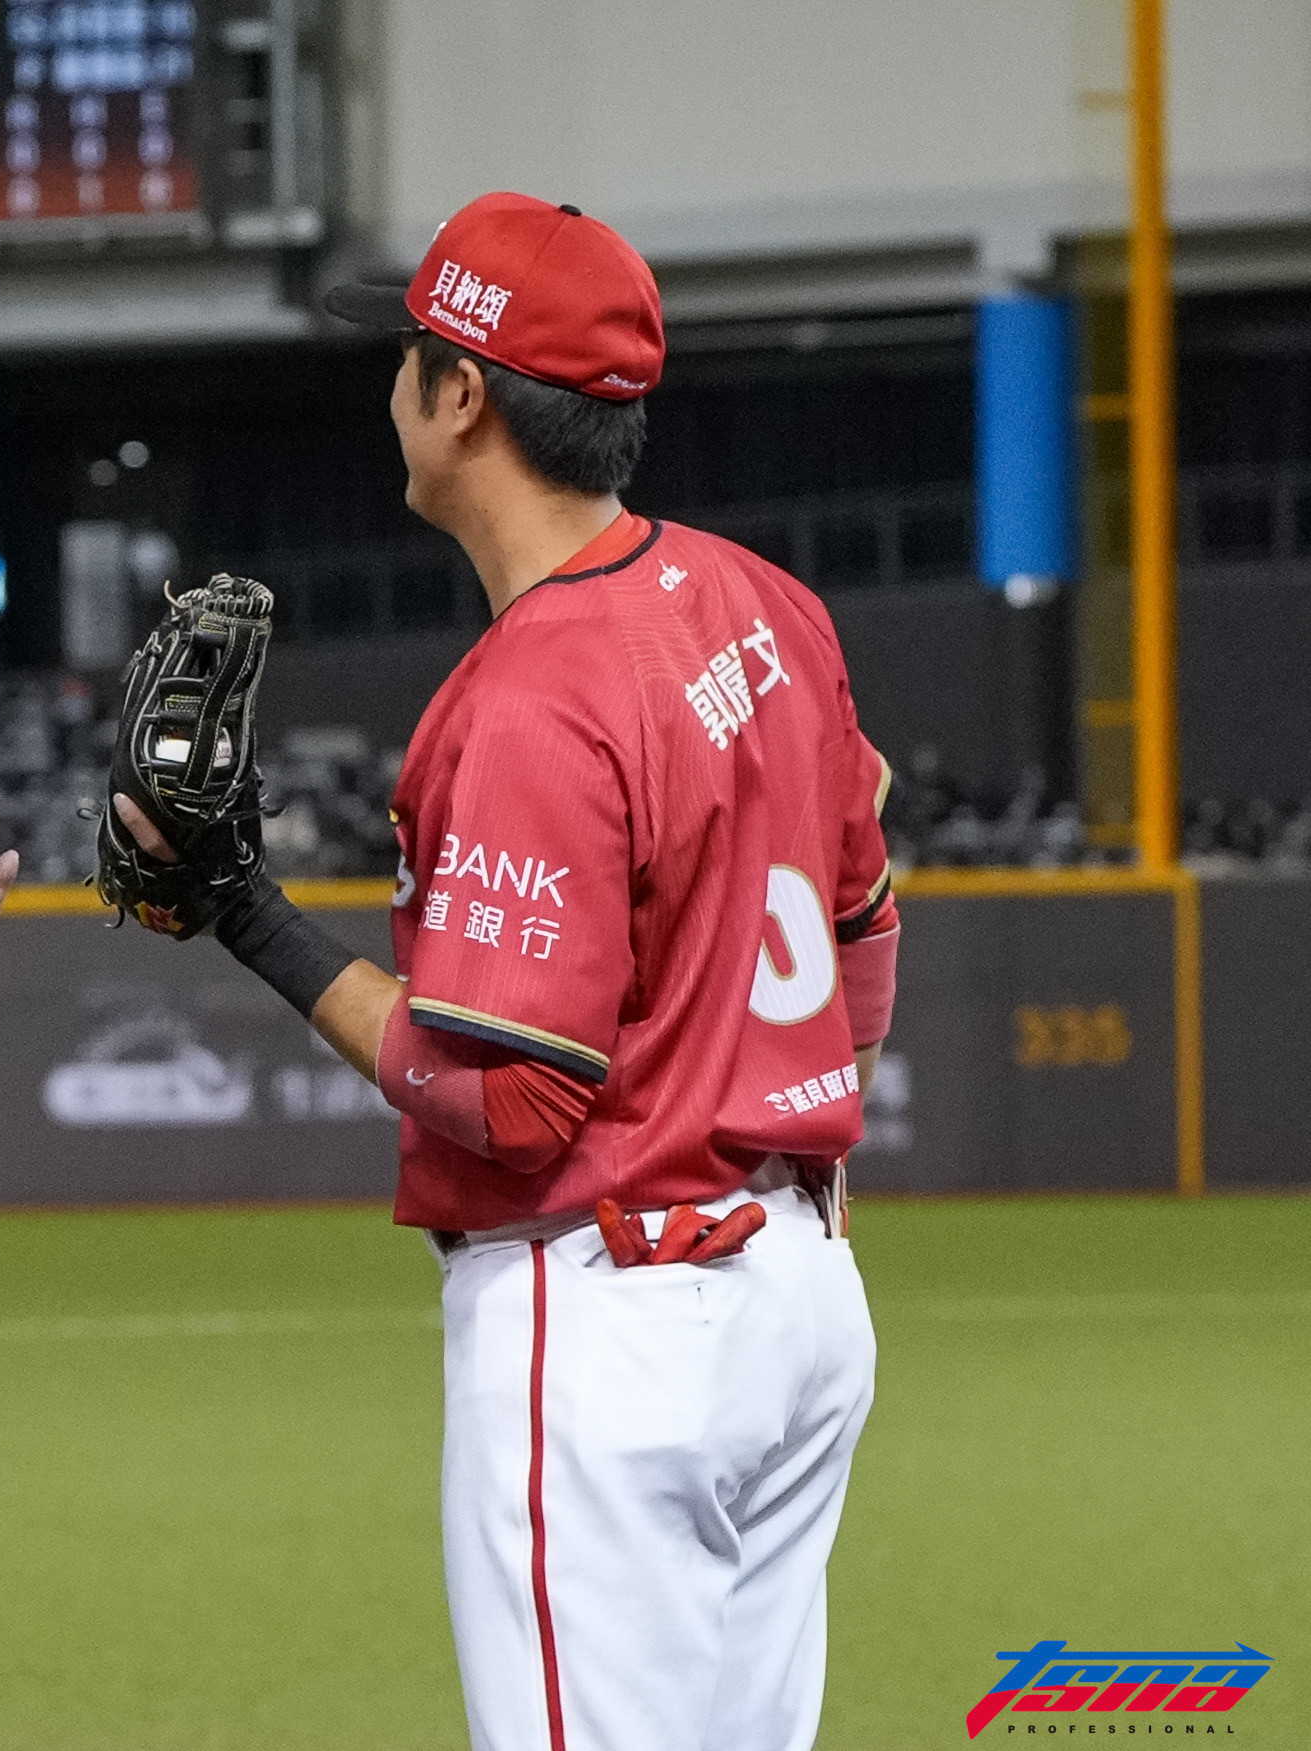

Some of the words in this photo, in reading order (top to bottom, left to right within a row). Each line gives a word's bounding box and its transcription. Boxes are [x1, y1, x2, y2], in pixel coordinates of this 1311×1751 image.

[427, 300, 488, 343] Bernachon
[428, 259, 513, 331] 貝納頌
[434, 834, 570, 907] BANK
[418, 890, 561, 960] 道銀行
